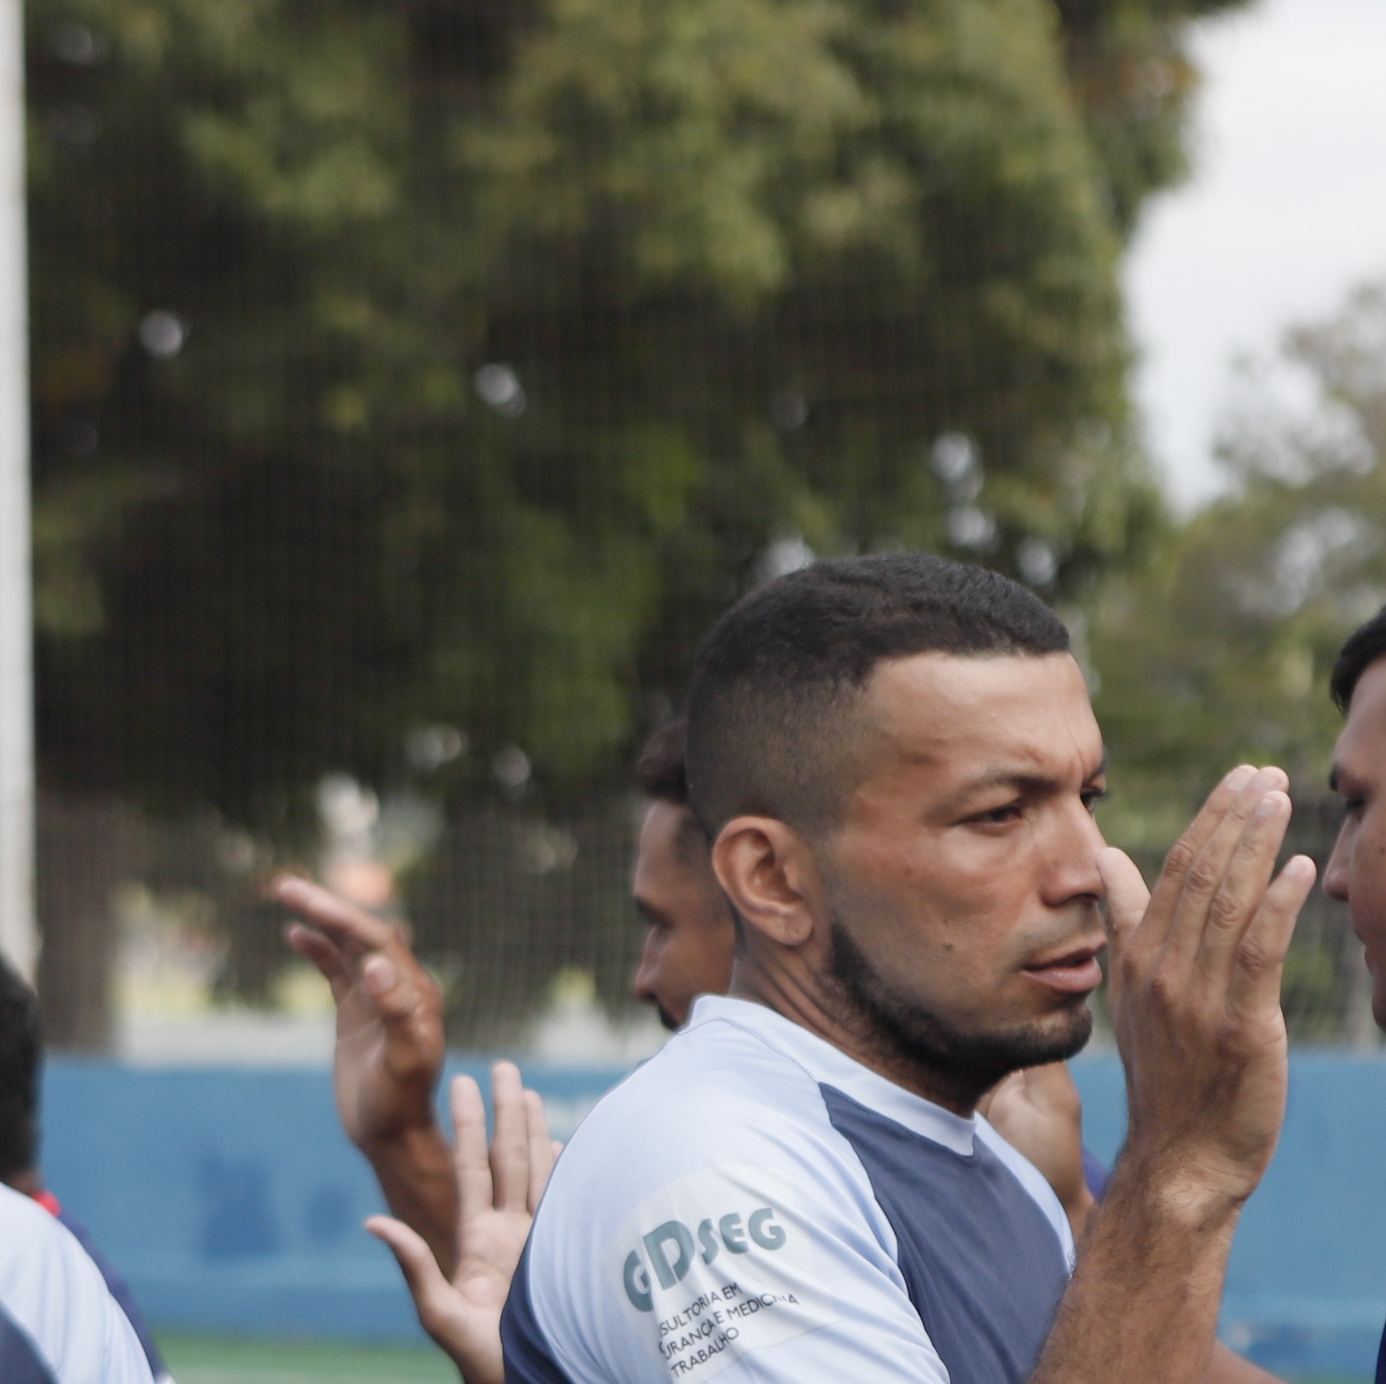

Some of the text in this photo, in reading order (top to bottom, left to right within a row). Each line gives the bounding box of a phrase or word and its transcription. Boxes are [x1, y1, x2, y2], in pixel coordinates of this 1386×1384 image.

[623, 1207, 787, 1313] GDSEG
[658, 1317, 716, 1361] URANÇA
[713, 1311, 724, 1325] E
[660, 1282, 743, 1337] SULTORIA EM
[670, 1327, 739, 1379] TRABALHO
